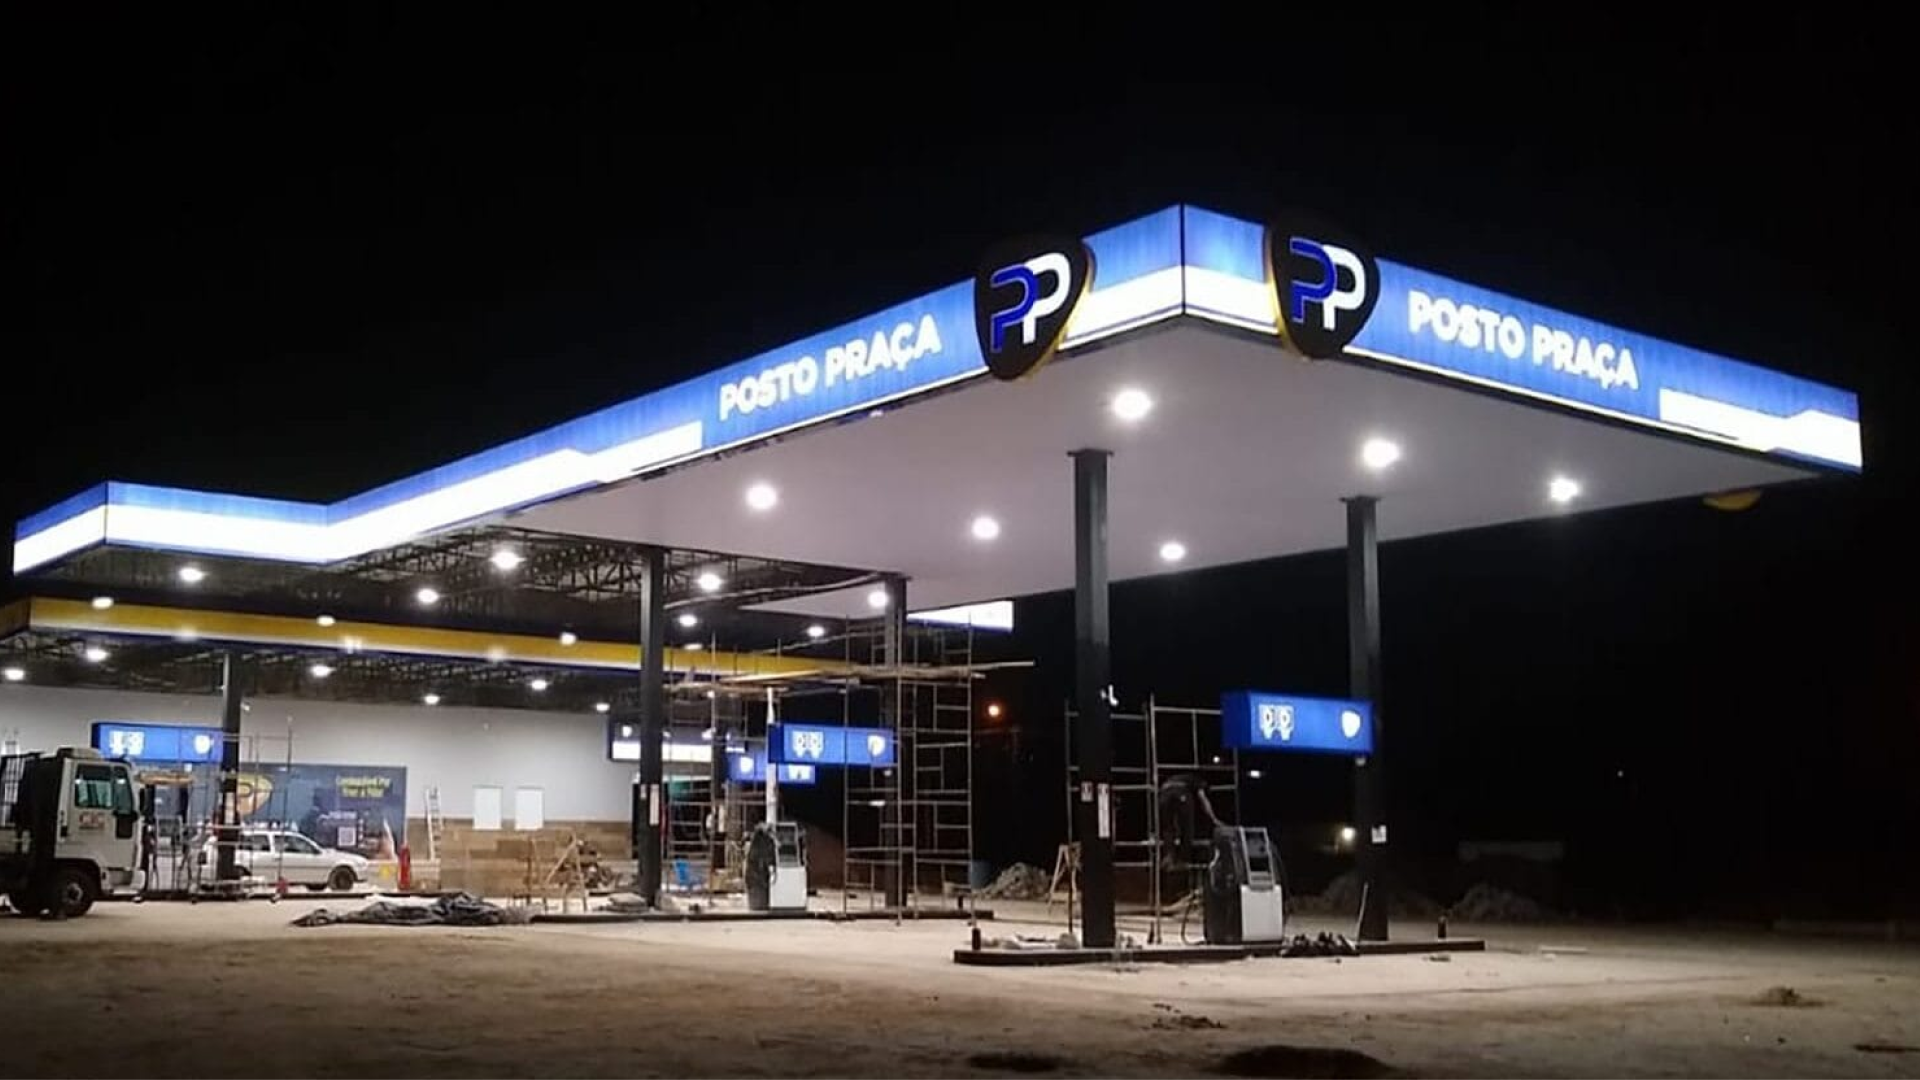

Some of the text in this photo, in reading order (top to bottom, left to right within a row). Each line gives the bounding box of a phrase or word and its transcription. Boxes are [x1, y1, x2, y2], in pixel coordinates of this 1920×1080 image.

[990, 251, 1072, 353] PP
[1289, 236, 1367, 331] PP
[719, 315, 941, 420] POSTO PRAÇA
[1408, 290, 1638, 390] POSTO PRAÇA
